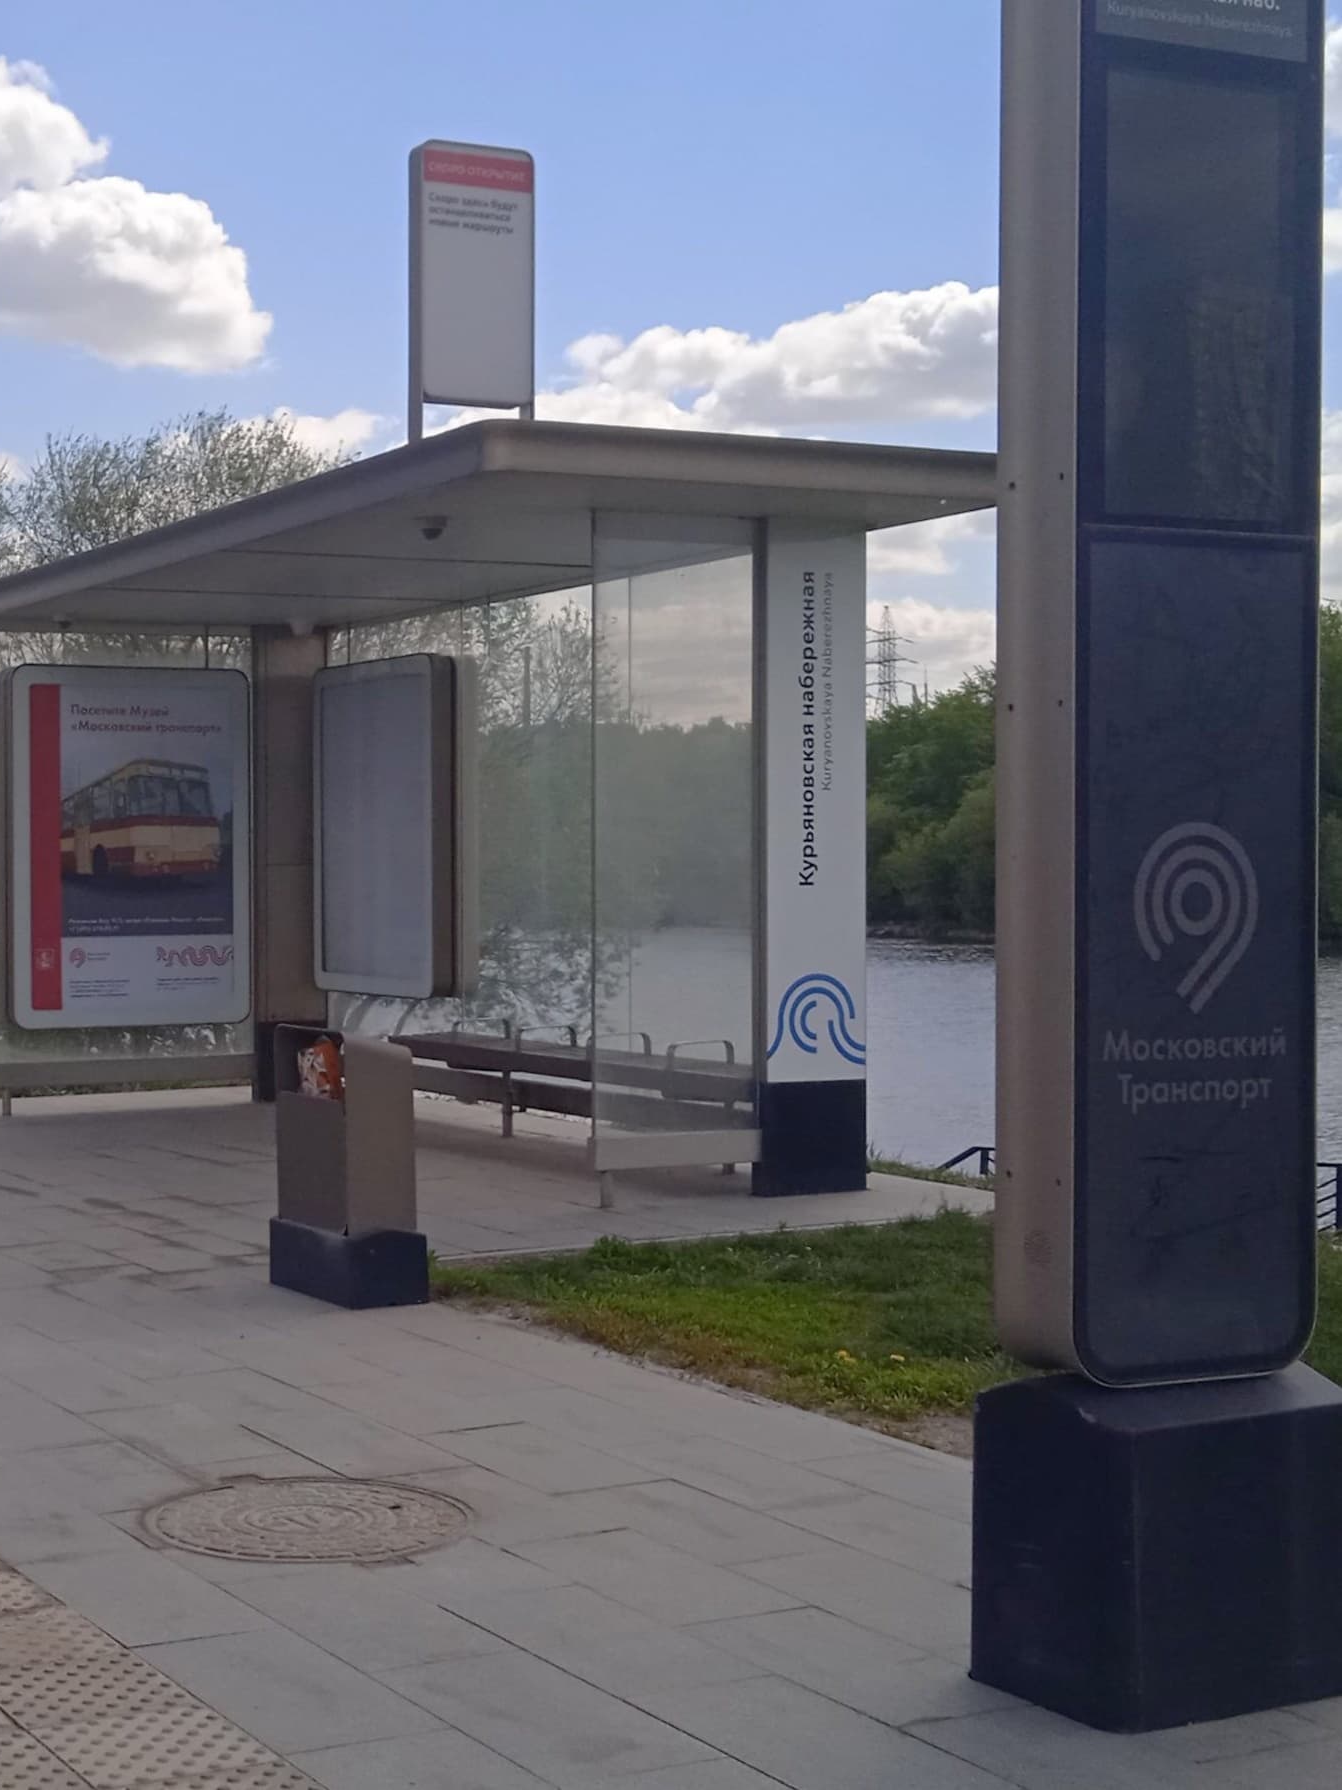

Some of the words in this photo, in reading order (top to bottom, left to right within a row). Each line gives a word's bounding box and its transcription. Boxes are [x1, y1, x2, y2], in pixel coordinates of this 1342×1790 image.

[798, 571, 819, 716] набережная
[821, 572, 834, 678] Naberezhnaya
[70, 703, 125, 716] Посетите
[130, 705, 170, 718] Музей
[821, 683, 834, 791] Kuryanovskaya
[798, 723, 819, 886] Курьяновская
[1102, 1027, 1286, 1061] Московский
[1117, 1073, 1273, 1114] Транспорт
